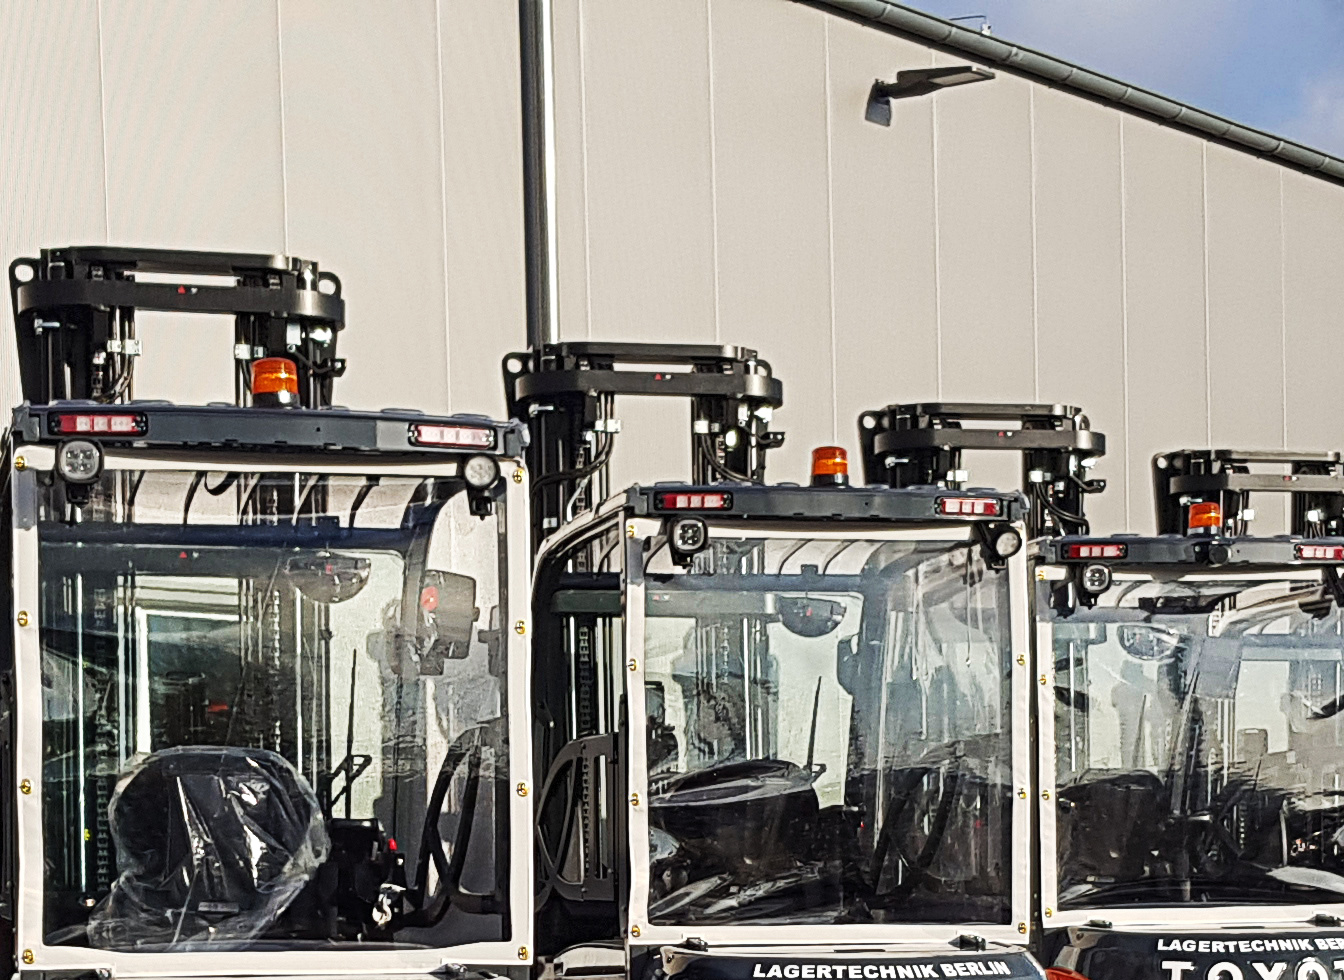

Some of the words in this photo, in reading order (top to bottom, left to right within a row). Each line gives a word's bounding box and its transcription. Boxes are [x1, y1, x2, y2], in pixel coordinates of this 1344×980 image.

[1157, 938, 1315, 953] LAGERTECHNIK
[752, 963, 940, 980] LAGERTECHNIK
[939, 961, 1012, 977] BERLIN
